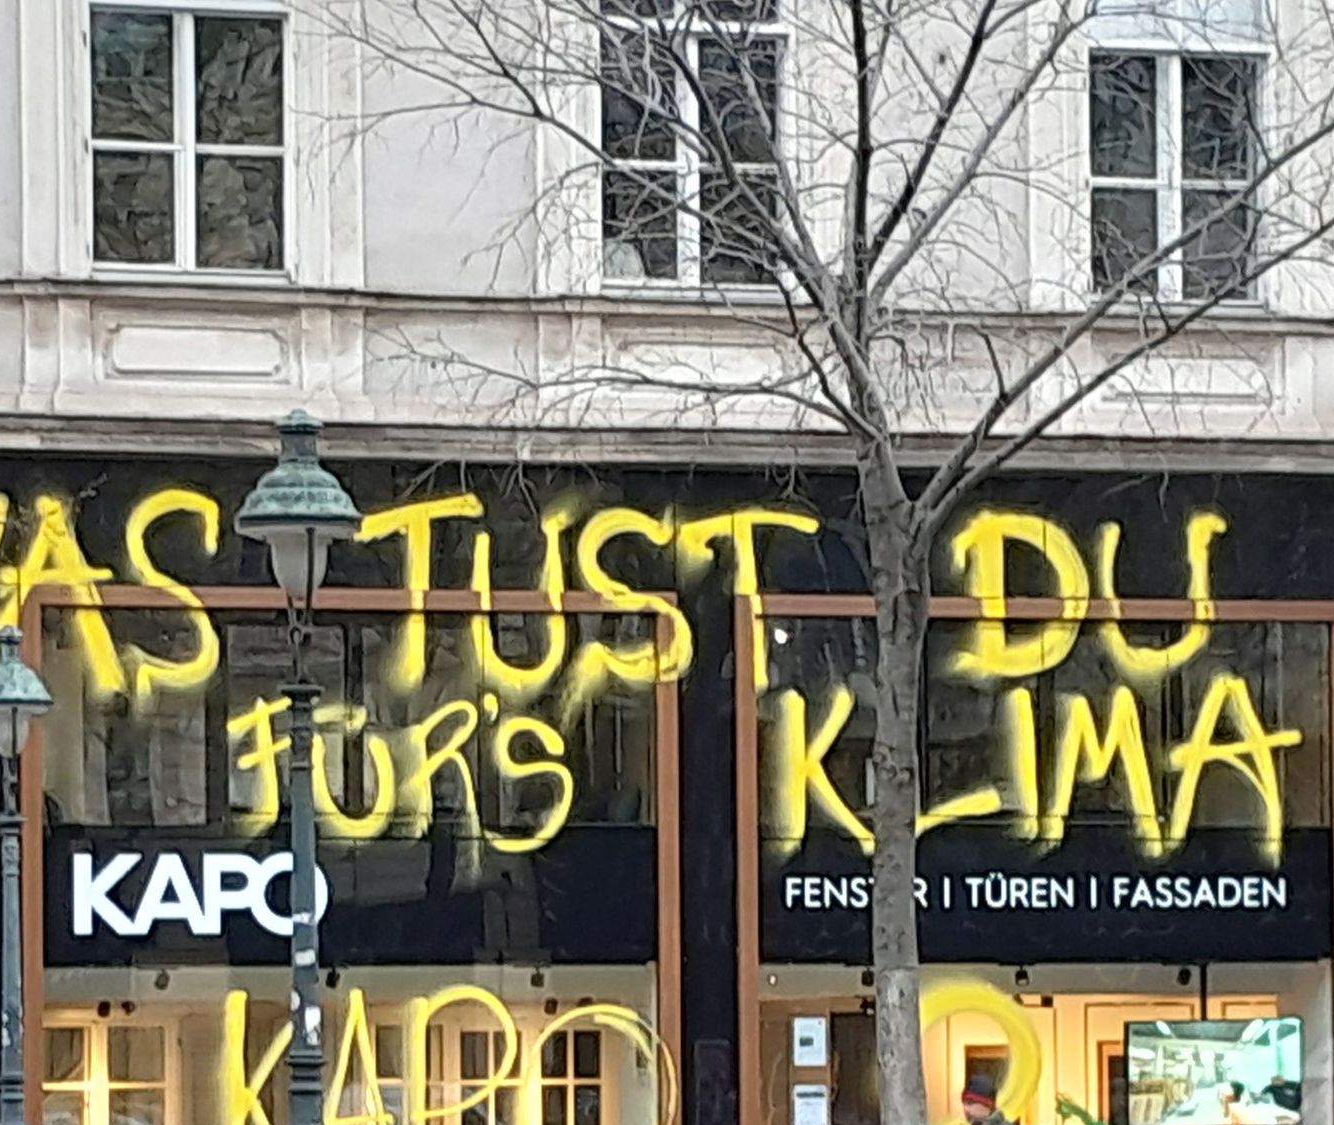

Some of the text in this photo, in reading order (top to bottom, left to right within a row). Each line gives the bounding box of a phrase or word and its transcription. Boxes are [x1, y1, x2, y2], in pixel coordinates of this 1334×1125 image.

[354, 493, 820, 692] TUST
[950, 512, 1228, 678] DU
[73, 853, 329, 936] KAPO
[785, 876, 929, 908] FENSR
[965, 871, 1075, 908] TÜREN
[1113, 876, 1287, 908] FASSADEN
